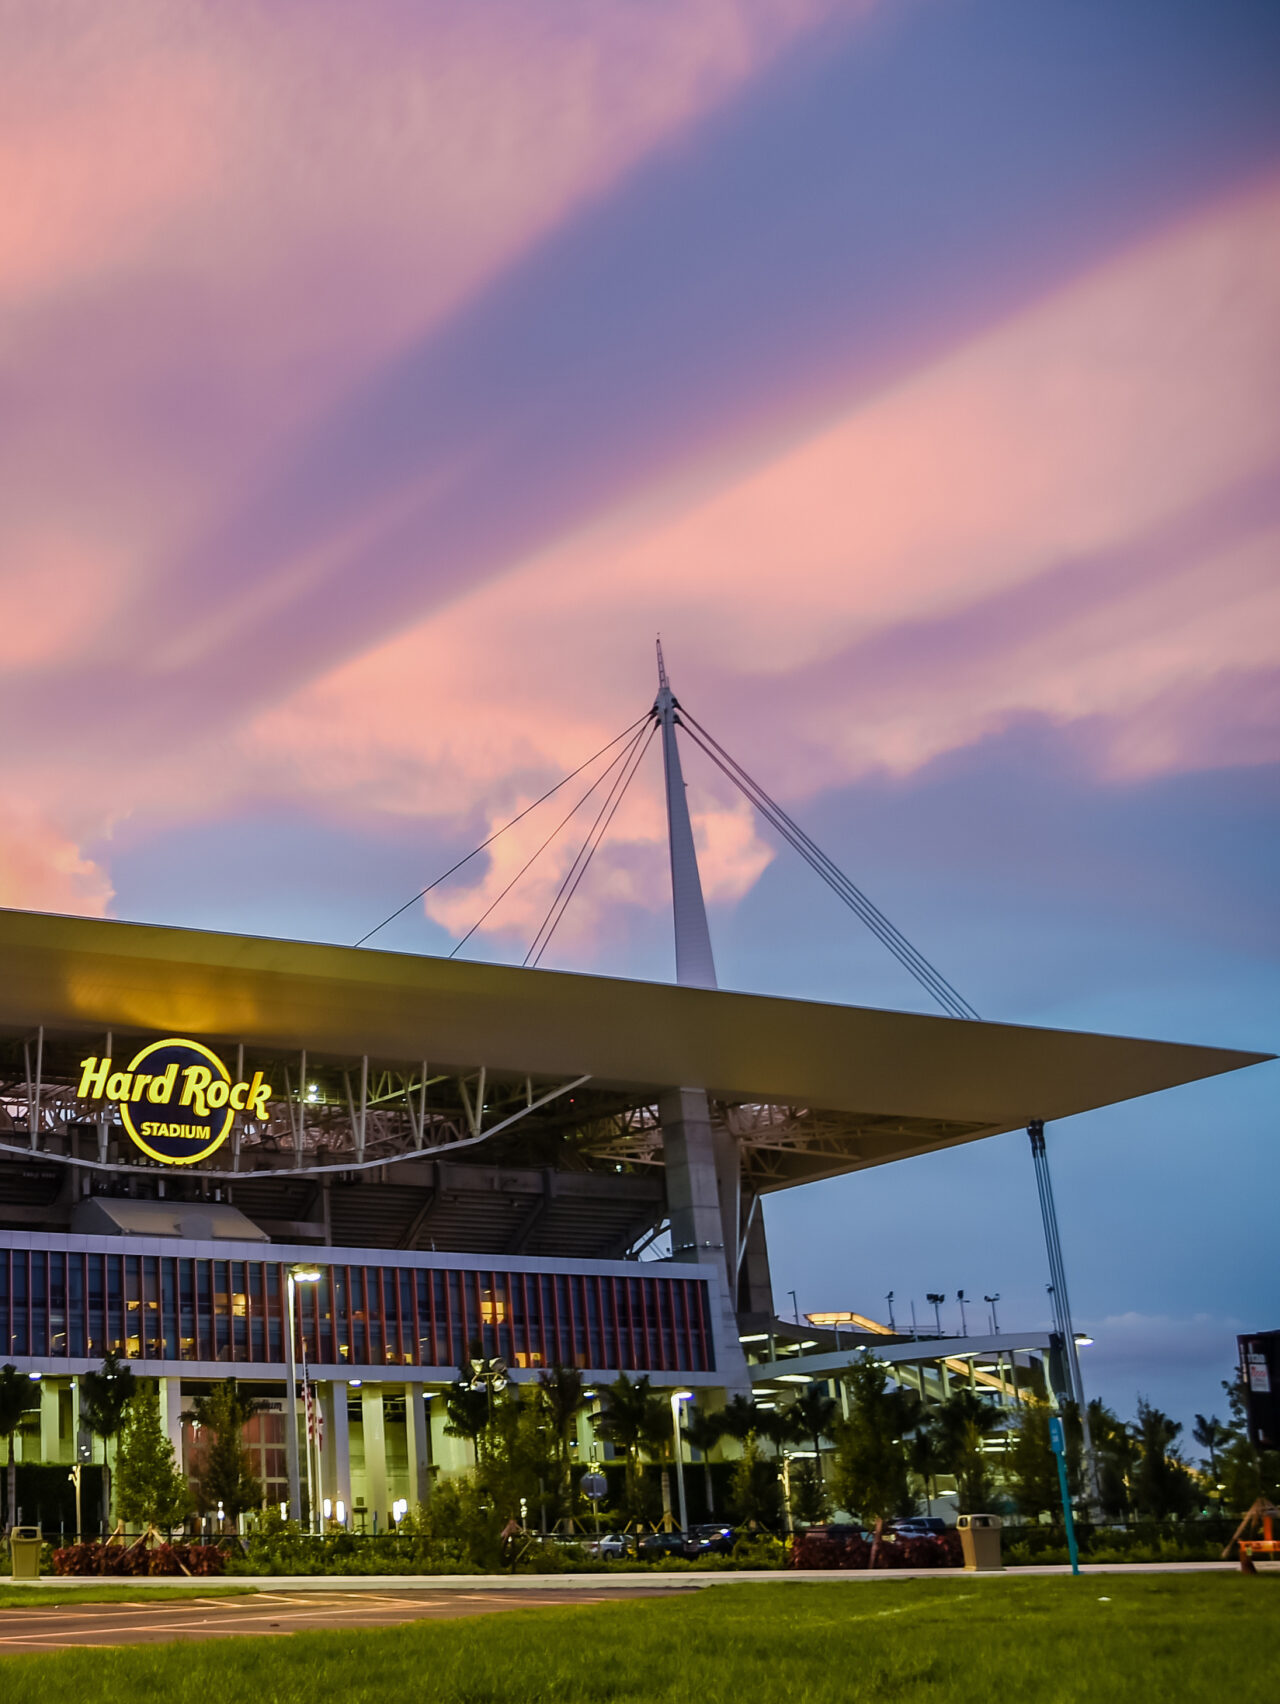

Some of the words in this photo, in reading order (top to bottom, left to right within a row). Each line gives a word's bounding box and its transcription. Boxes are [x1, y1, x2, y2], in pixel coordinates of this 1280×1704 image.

[77, 1057, 180, 1104] Hard
[179, 1065, 272, 1120] Rock
[140, 1121, 211, 1140] STADIUM
